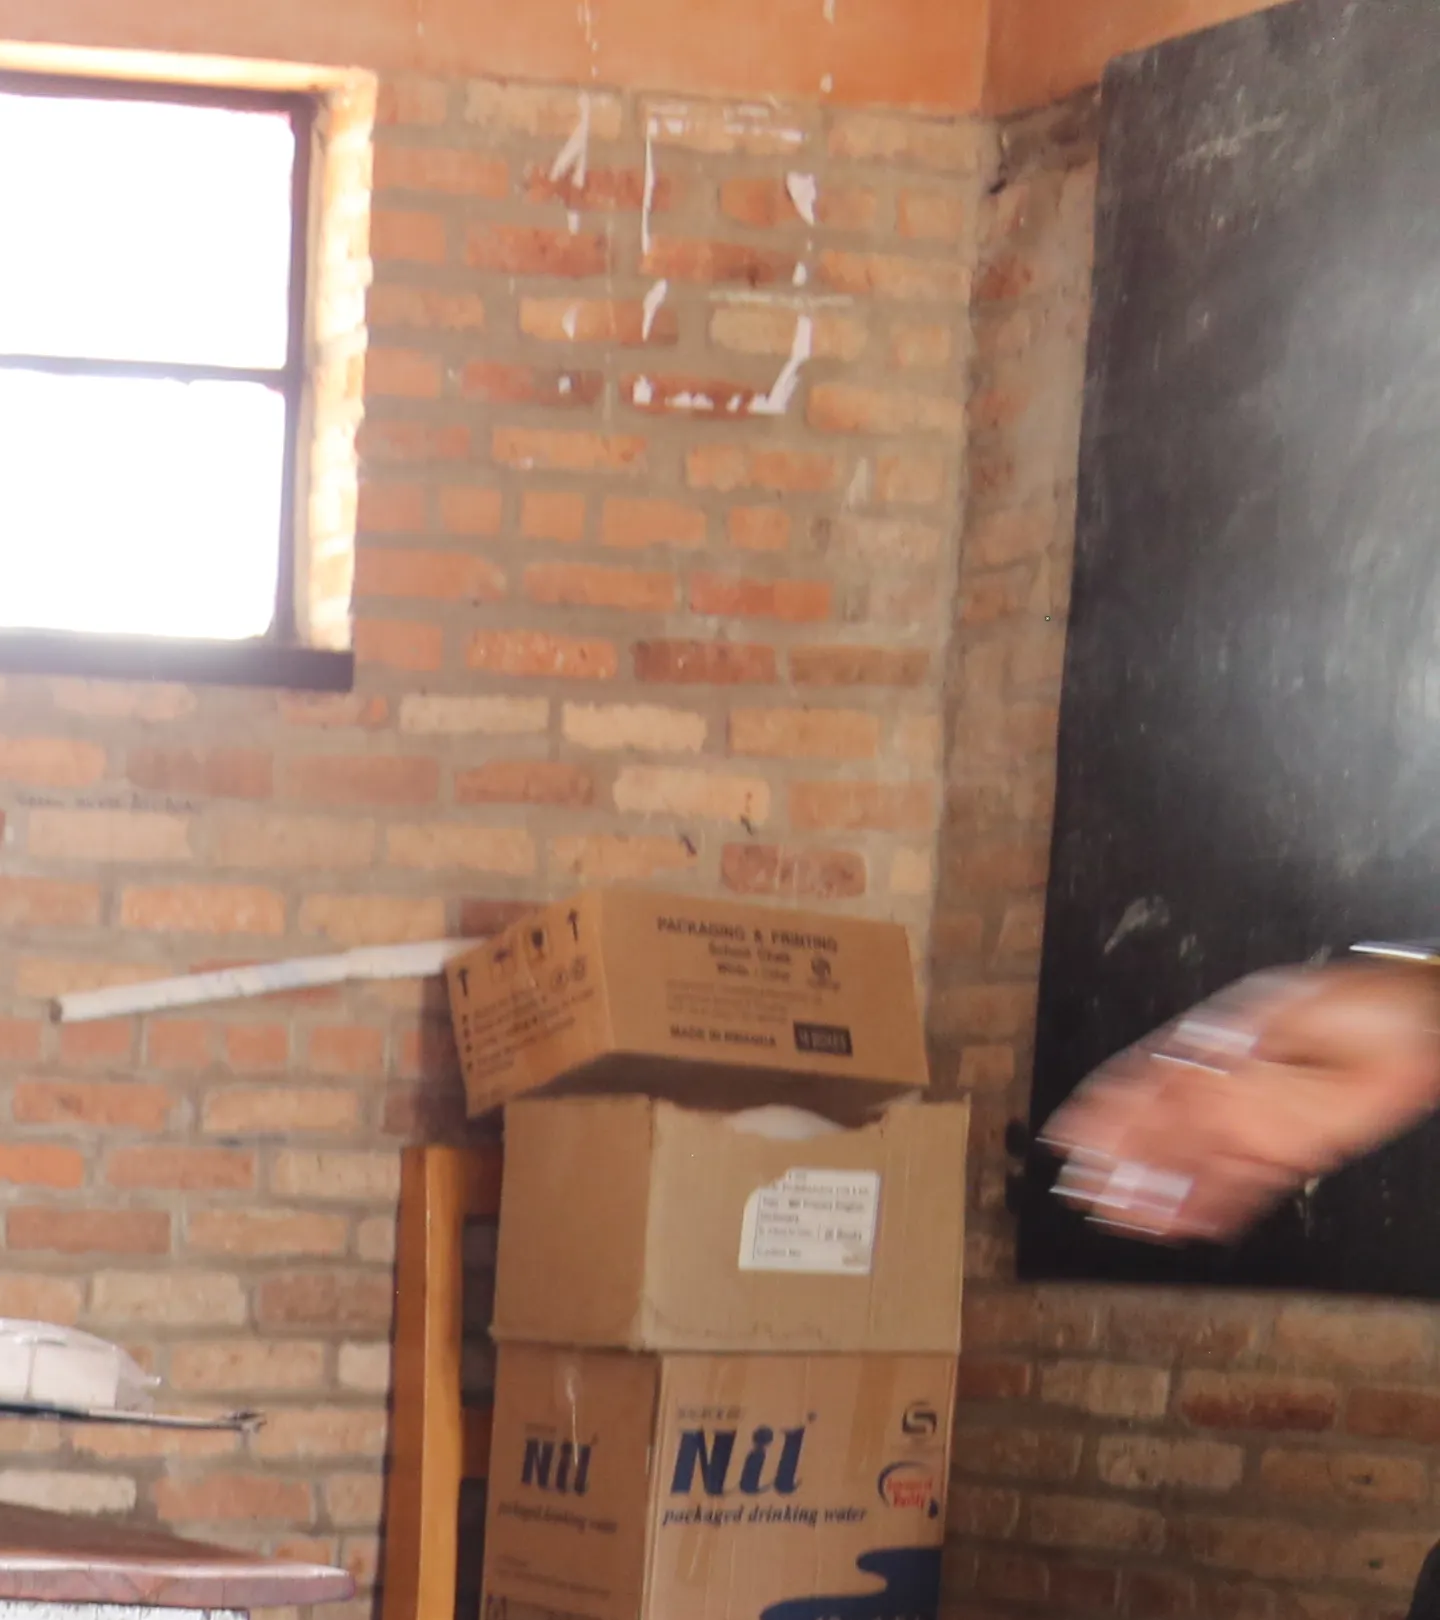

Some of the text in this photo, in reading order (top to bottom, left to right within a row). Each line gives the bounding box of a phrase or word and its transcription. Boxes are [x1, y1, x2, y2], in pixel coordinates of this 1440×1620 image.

[521, 1438, 592, 1497] Nil
[670, 1424, 807, 1496] Nil
[662, 1506, 868, 1527] packaged drinking water
